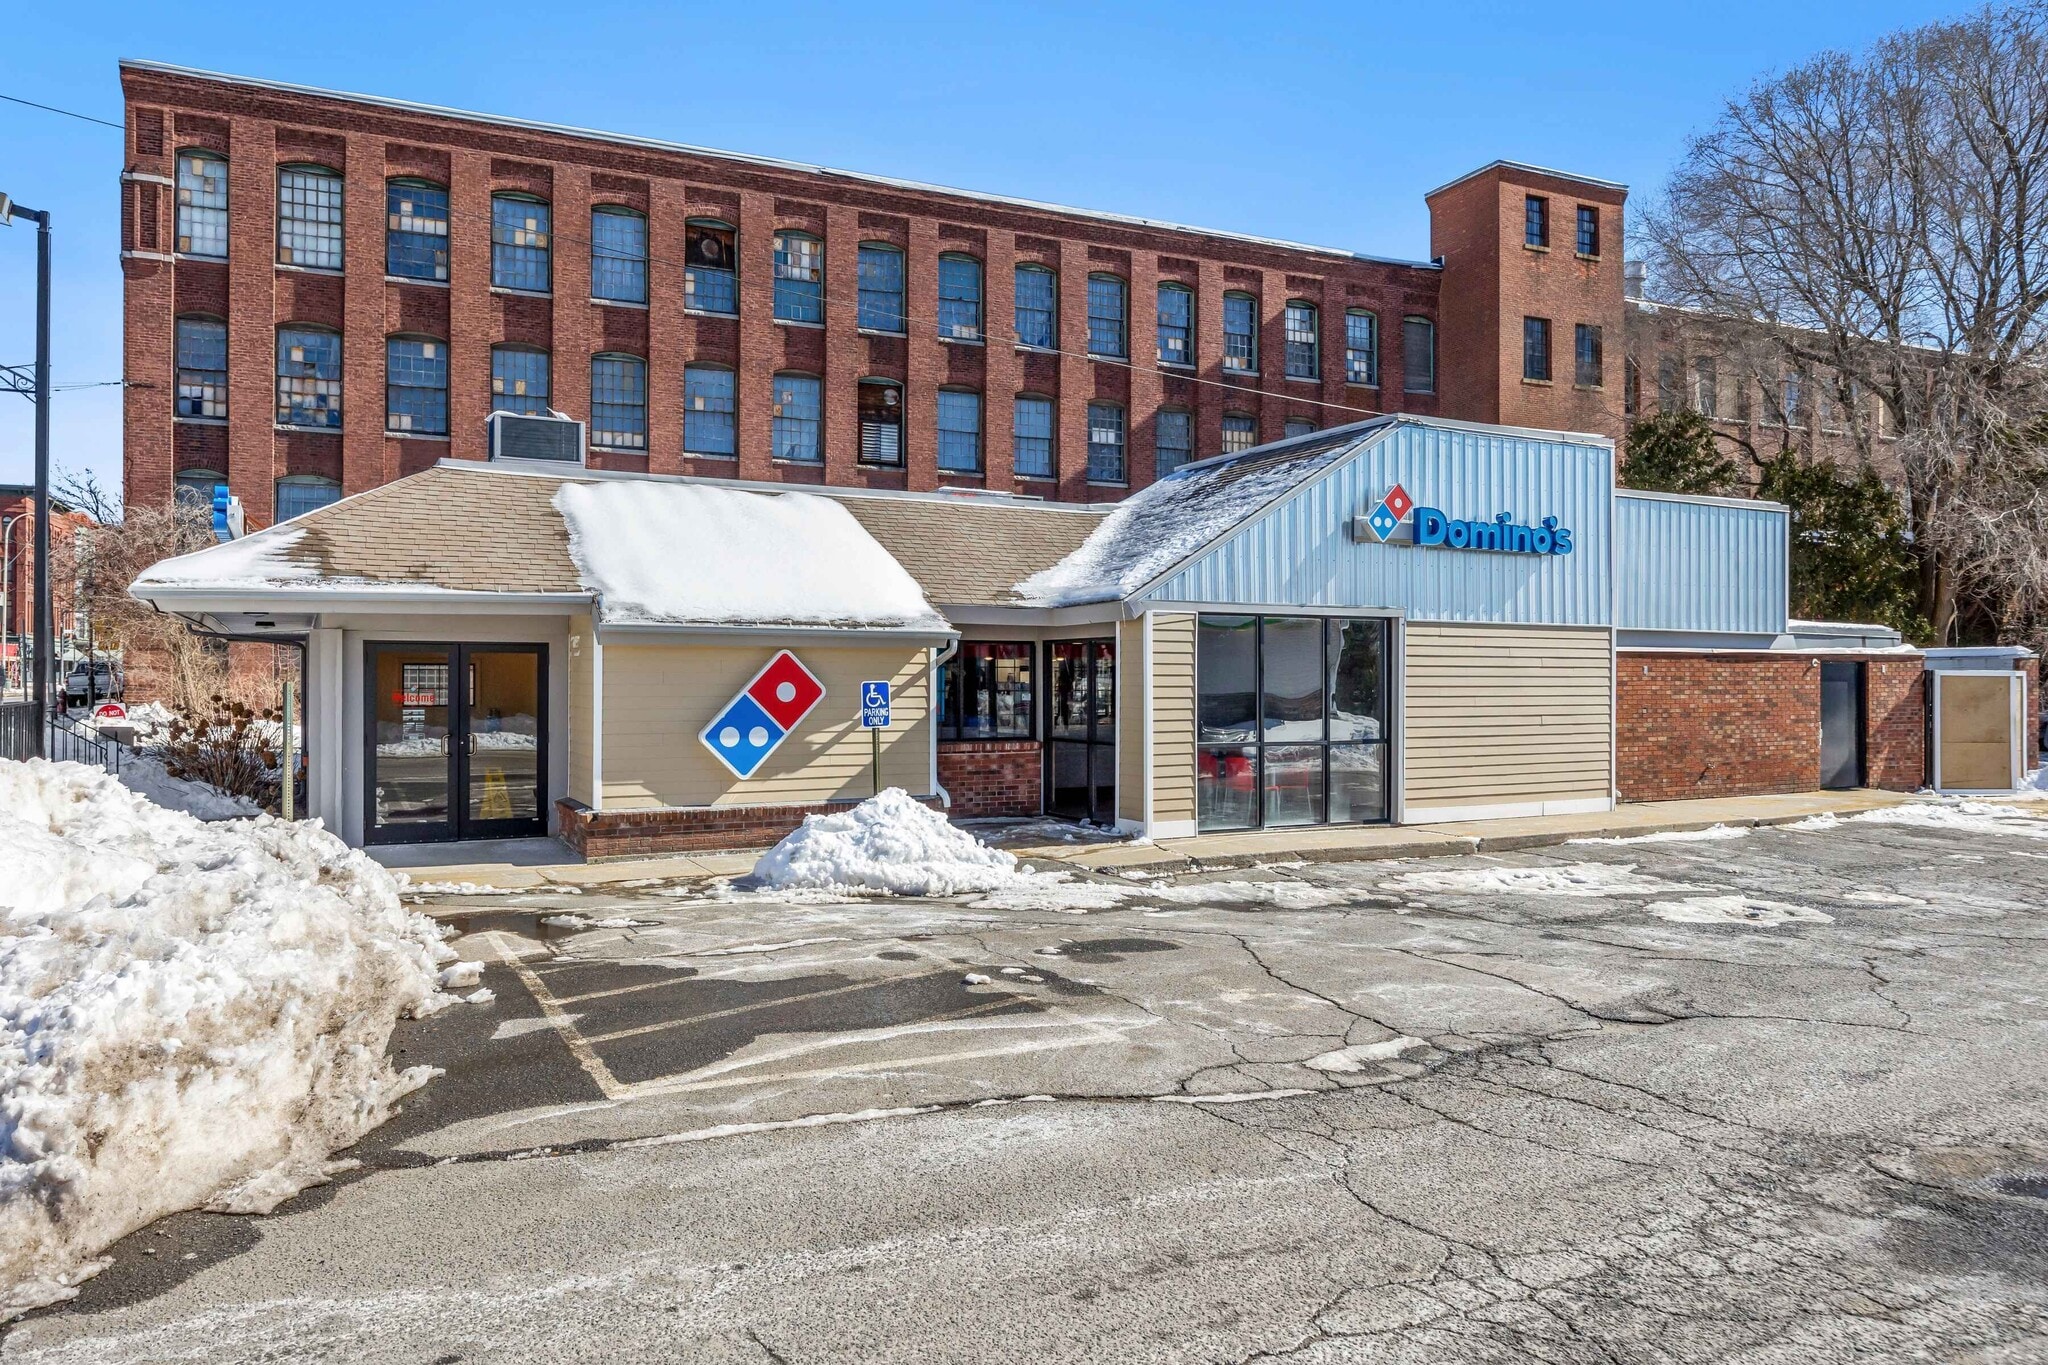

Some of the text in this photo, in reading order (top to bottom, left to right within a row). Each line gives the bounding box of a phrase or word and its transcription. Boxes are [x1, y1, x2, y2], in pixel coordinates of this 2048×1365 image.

[1413, 507, 1572, 555] Domino's
[864, 708, 888, 717] PARKING
[869, 717, 884, 725] ONLY
